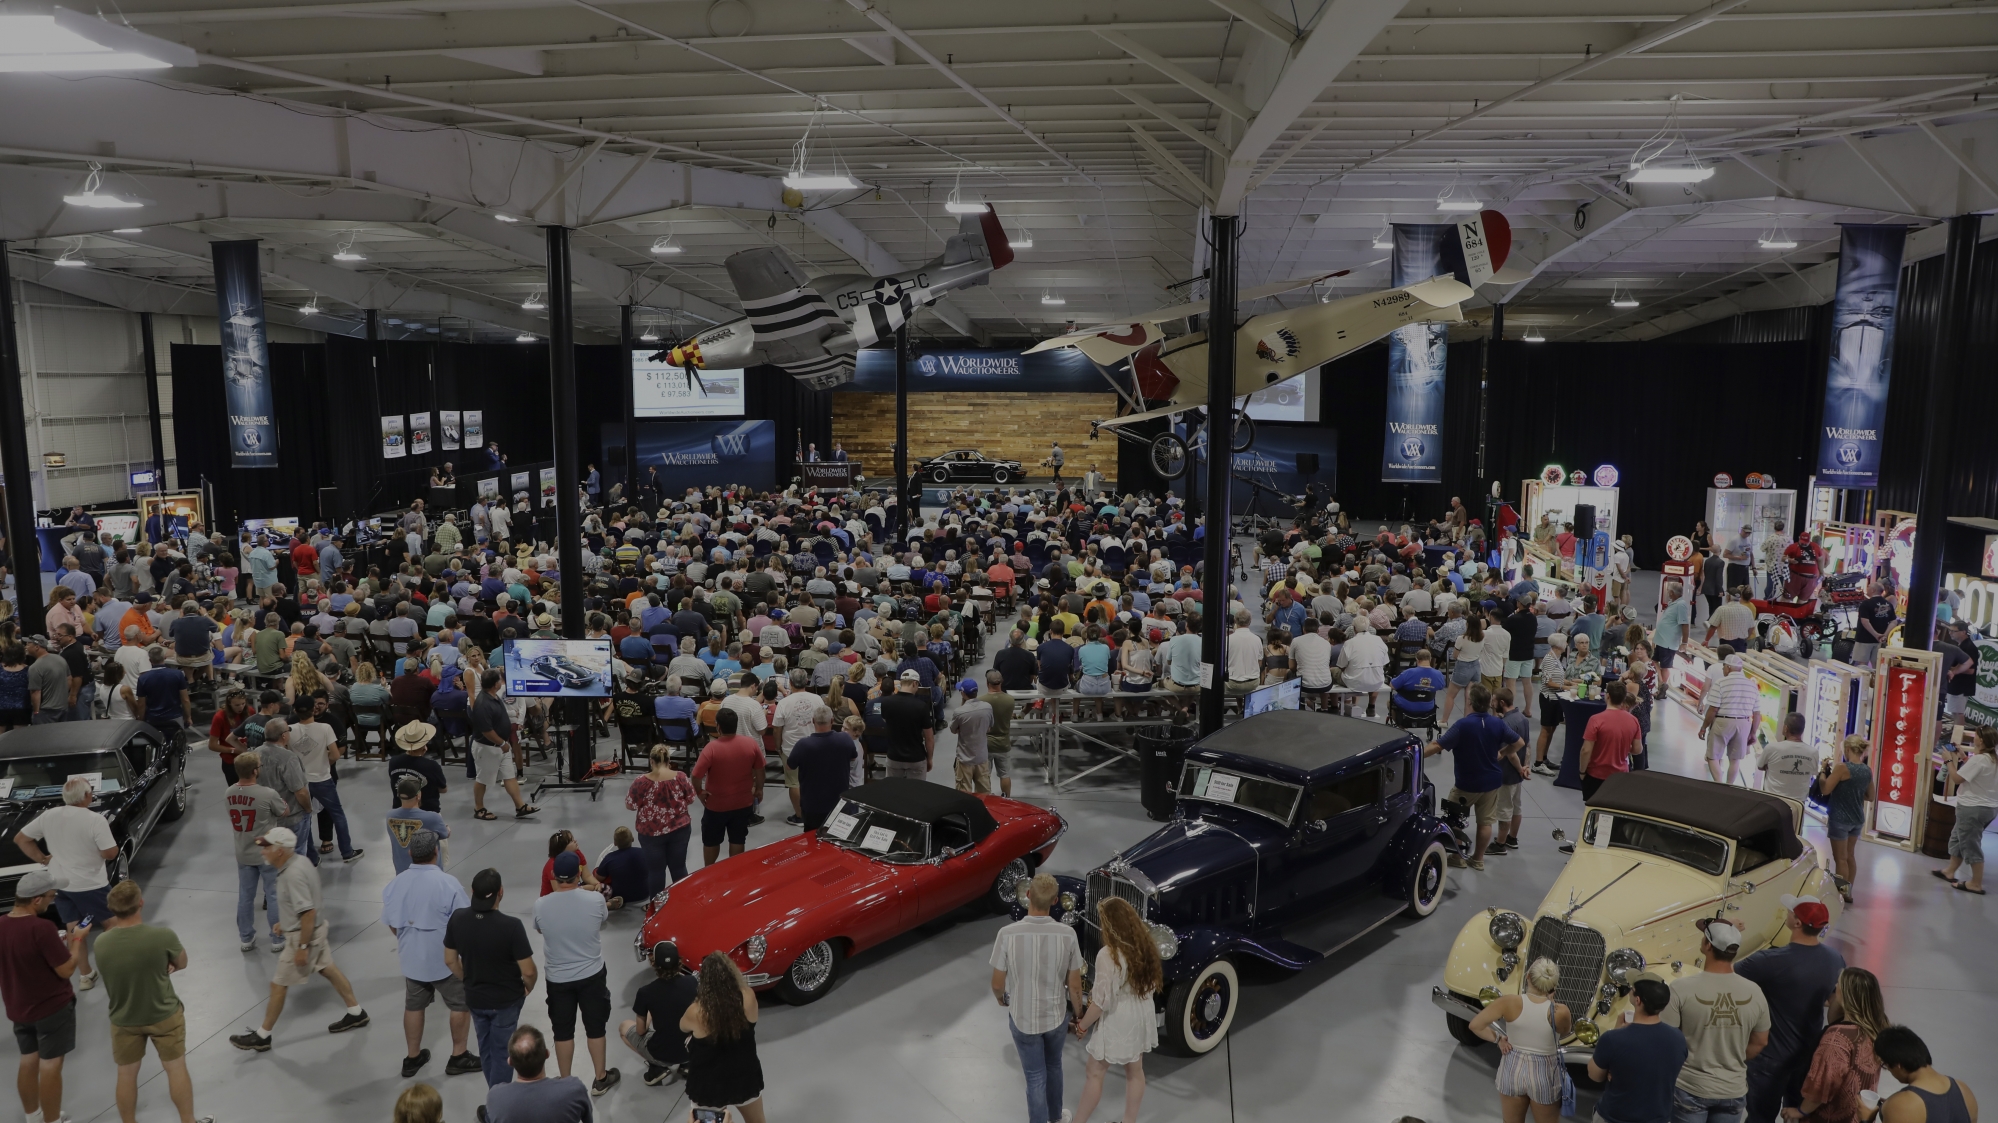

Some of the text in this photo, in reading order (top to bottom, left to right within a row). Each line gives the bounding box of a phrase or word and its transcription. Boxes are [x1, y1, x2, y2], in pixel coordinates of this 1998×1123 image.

[1463, 221, 1478, 240] N
[1465, 238, 1483, 250] 684
[917, 273, 930, 288] C
[836, 291, 859, 310] C5
[1373, 292, 1410, 308] N42989
[938, 356, 1019, 374] WORLDWIDE
[231, 416, 268, 425] WORLDWIDE
[1389, 422, 1438, 434] WORLDWIDE
[1825, 427, 1876, 439] WORLDWIDE
[662, 452, 718, 465] WORLDWIDE
[806, 467, 847, 476] WORLDWIDE
[1890, 672, 1917, 801] Firestone
[227, 795, 255, 806] TROUT
[230, 809, 256, 832] 27
